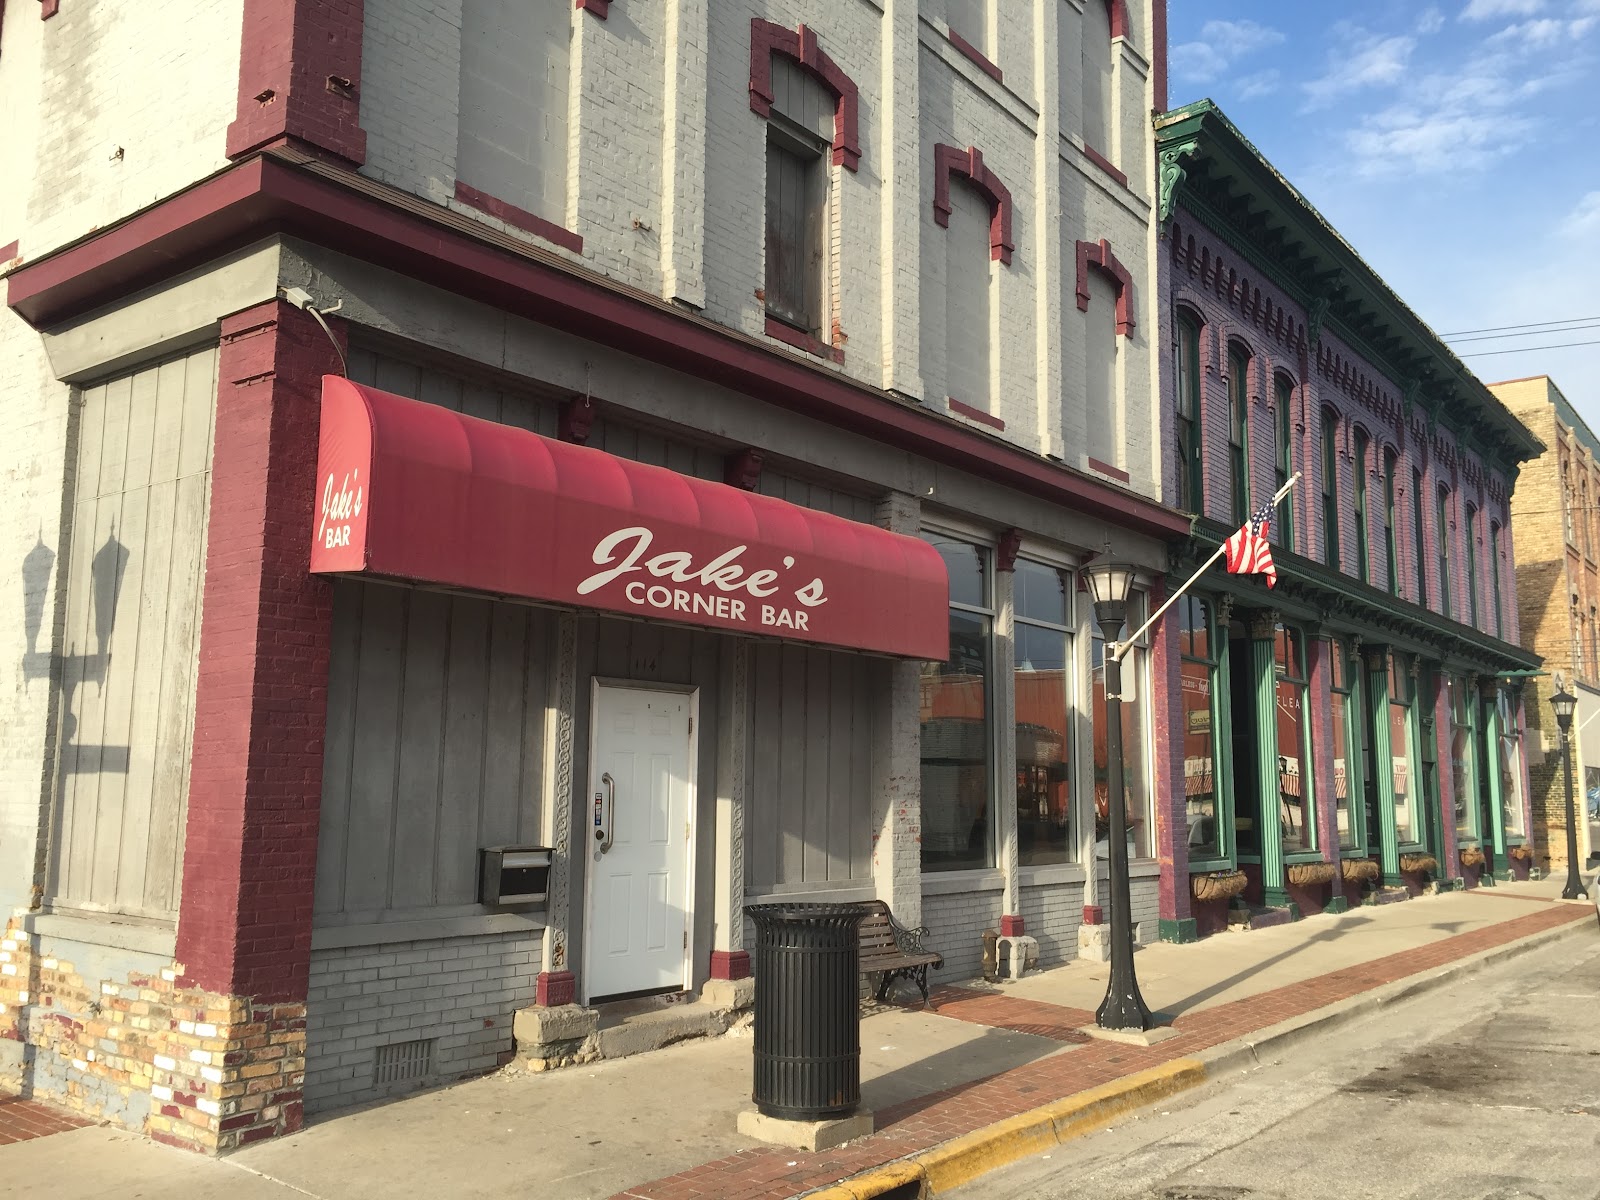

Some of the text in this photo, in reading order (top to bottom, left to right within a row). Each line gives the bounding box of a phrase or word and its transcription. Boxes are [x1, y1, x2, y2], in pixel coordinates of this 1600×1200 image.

[318, 468, 362, 541] Jake's
[325, 525, 351, 549] BAR
[576, 526, 828, 607] Jake's
[625, 581, 746, 622] CORNER
[761, 604, 809, 631] BAR
